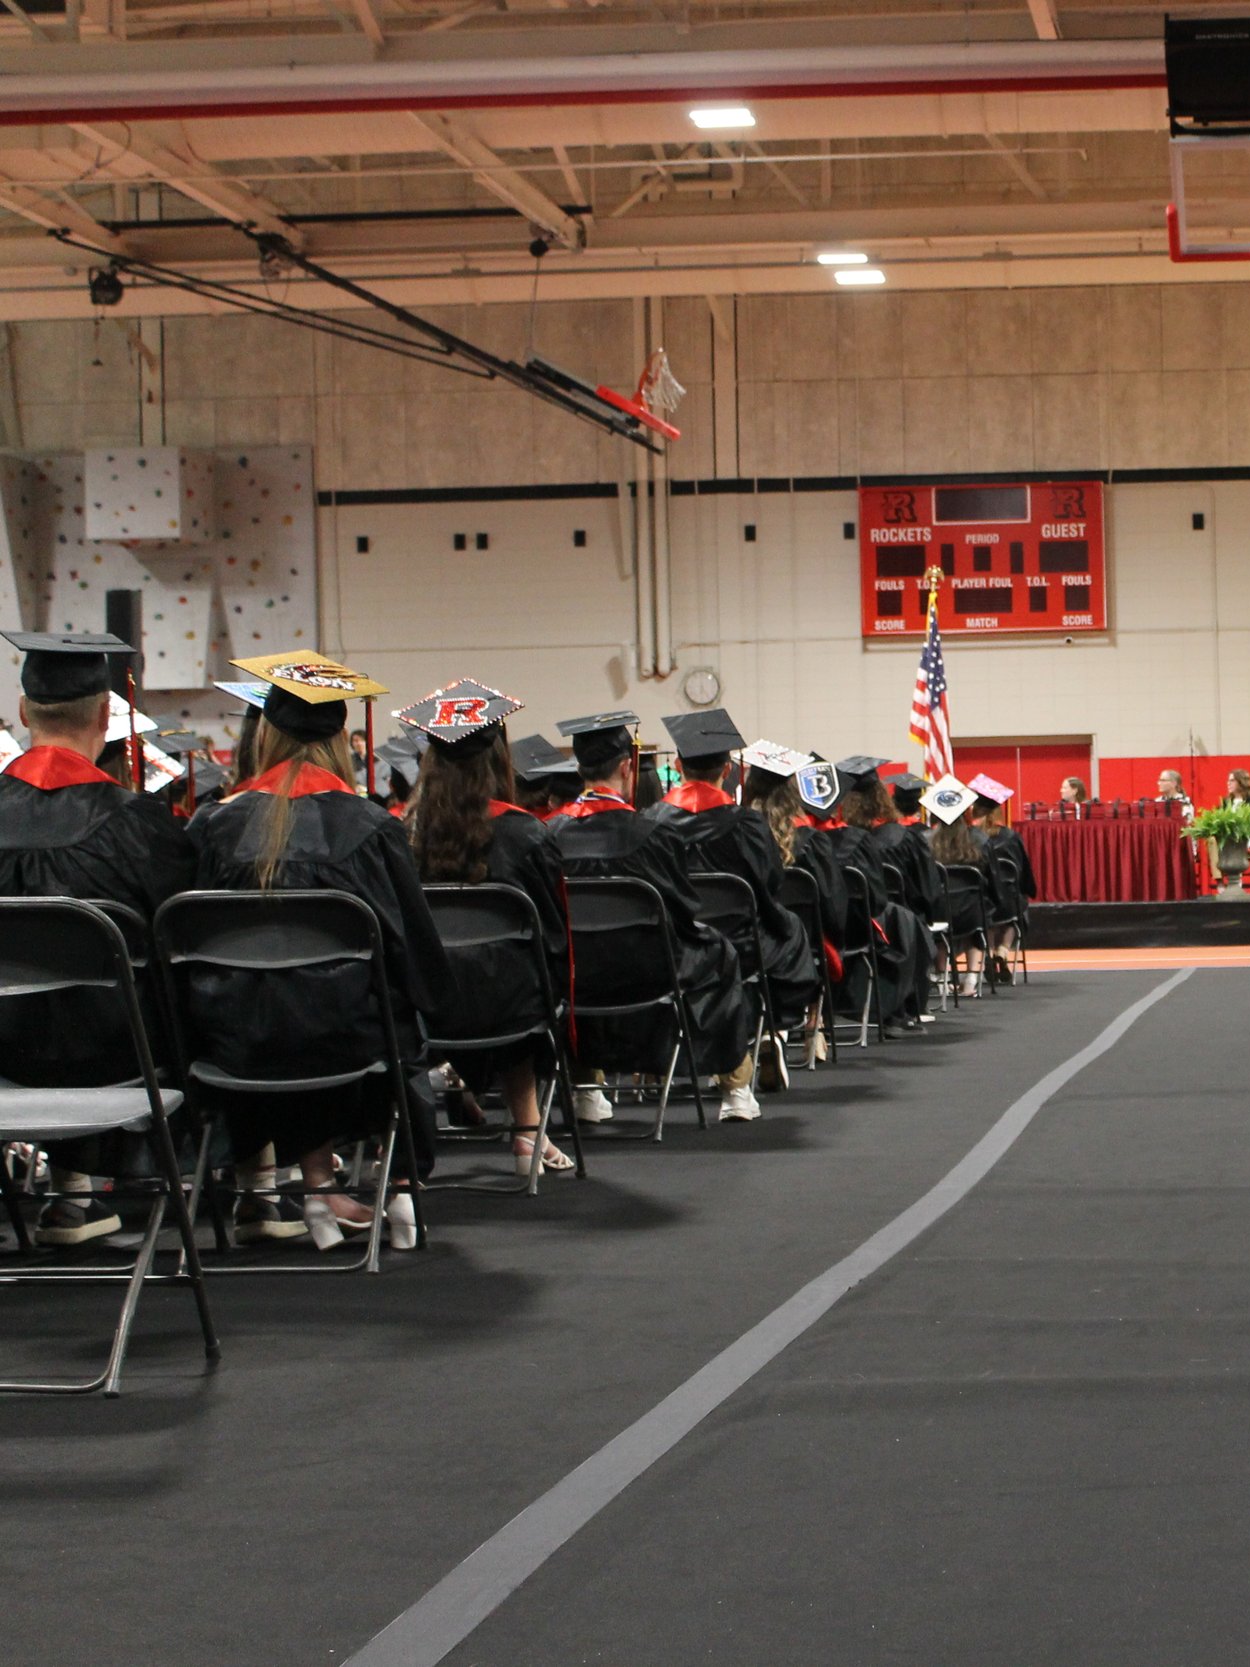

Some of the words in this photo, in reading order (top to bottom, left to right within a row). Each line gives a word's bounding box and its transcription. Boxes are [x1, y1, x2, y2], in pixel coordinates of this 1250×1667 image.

[882, 490, 918, 523] R
[1052, 485, 1086, 518] R
[870, 527, 932, 543] ROCKETS
[1041, 523, 1086, 538] GUEST
[965, 533, 1000, 544] PERIOD
[874, 580, 905, 591] FOULS
[951, 577, 986, 589] PLAYER
[989, 576, 1013, 588] FOUL
[1061, 575, 1092, 586] FOULS
[874, 619, 906, 631] SCORE
[965, 617, 998, 628] MATCH
[1062, 615, 1093, 626] SCORE
[271, 667, 356, 692] ELON
[429, 696, 489, 728] R
[807, 773, 832, 799] B
